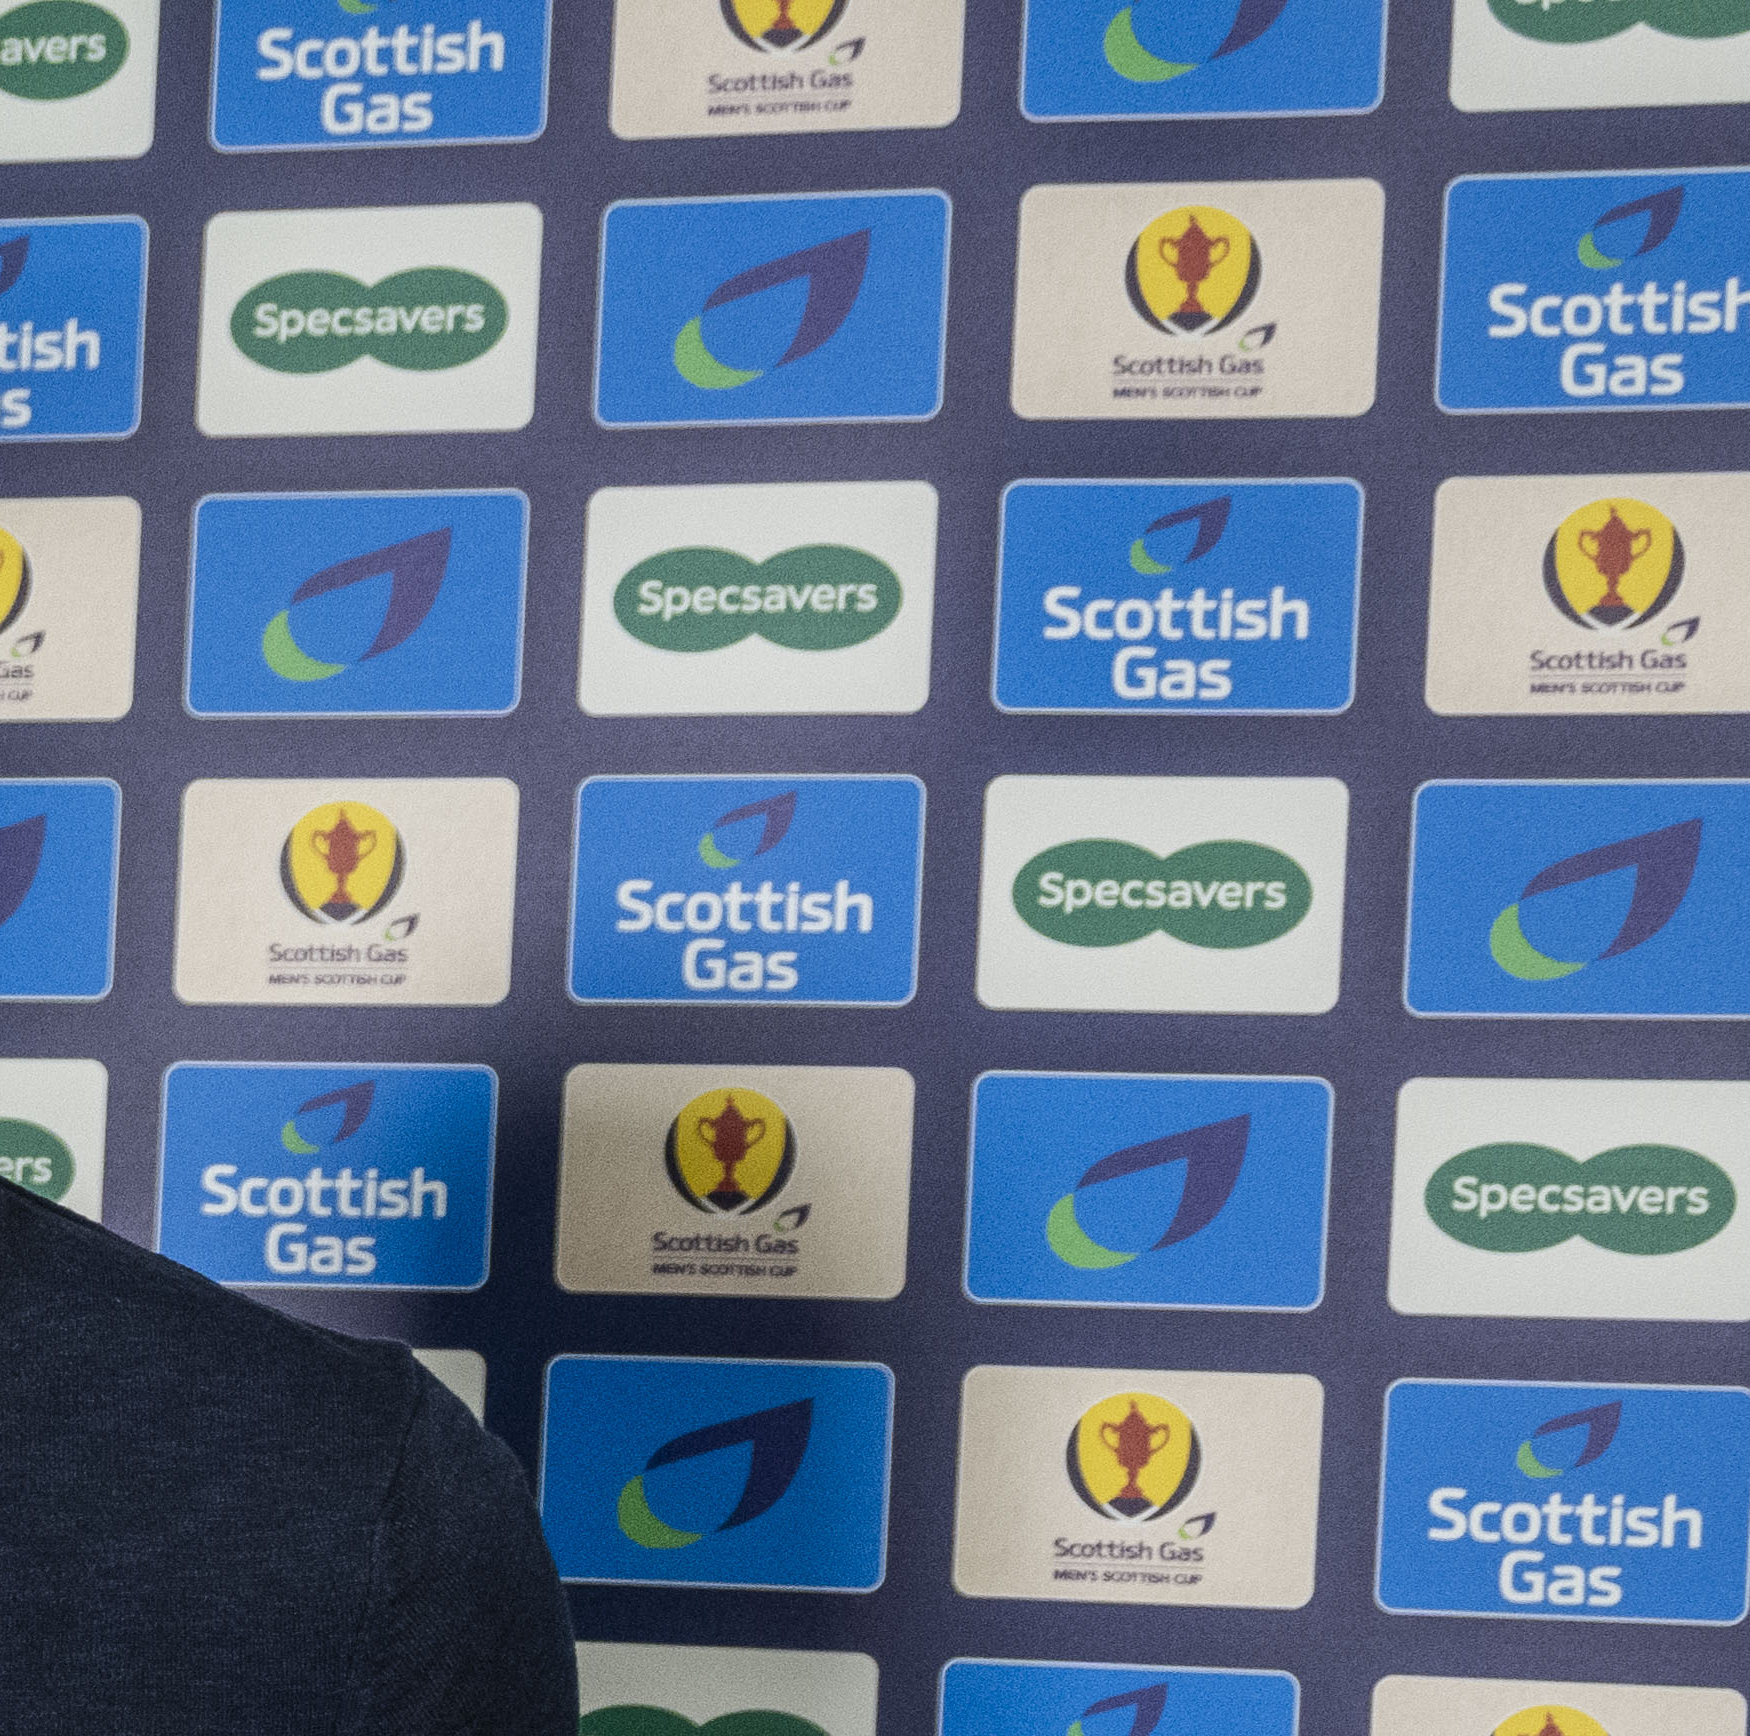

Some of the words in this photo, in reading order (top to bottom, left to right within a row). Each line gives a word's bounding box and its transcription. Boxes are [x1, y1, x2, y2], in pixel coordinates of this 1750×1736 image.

[258, 20, 504, 80] Scottish
[321, 82, 433, 135] Gas
[709, 73, 804, 93] Scottish
[810, 71, 852, 89] Gas
[255, 303, 484, 342] Specsavers
[1114, 357, 1211, 375] Scottish
[1220, 356, 1264, 375] Gas
[1560, 342, 1684, 397] Gas
[638, 580, 877, 622] Specsavers
[1044, 586, 1309, 640] Scottish
[1113, 646, 1232, 699] Gas
[1531, 651, 1633, 671] Scottish
[1641, 651, 1687, 670] Gas
[617, 879, 873, 932] Scottish
[1039, 871, 1286, 913] Specsavers
[269, 944, 360, 962] Scottish
[367, 945, 407, 963] Gas
[683, 938, 798, 991] Gas
[200, 1163, 445, 1217] Scottish
[1452, 1176, 1709, 1218] Specsavers
[266, 1223, 378, 1276] Gas
[654, 1233, 748, 1252] Scottish
[755, 1234, 798, 1254] Gas
[1429, 1487, 1702, 1548] Scottish
[1055, 1538, 1151, 1559] Scottish
[1159, 1542, 1204, 1562] Gas
[1499, 1550, 1622, 1606] Gas
